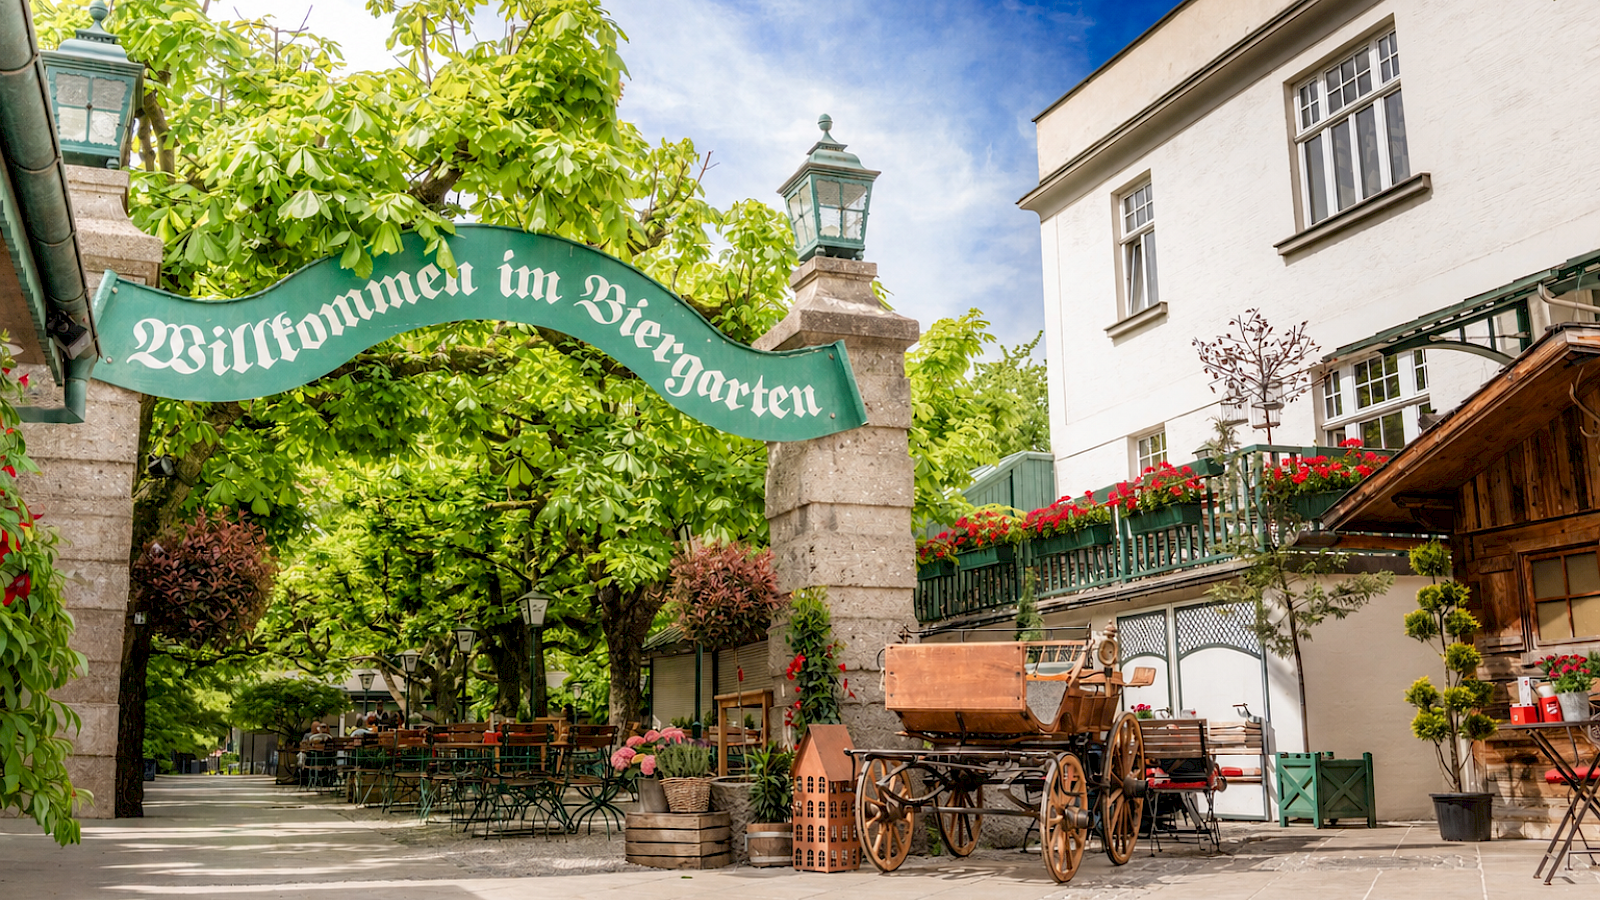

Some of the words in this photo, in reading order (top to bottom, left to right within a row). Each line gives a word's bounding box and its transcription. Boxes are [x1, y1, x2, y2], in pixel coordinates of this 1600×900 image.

[126, 261, 478, 376] Willkommen
[497, 249, 562, 304] im
[573, 274, 823, 419] Biergarten
